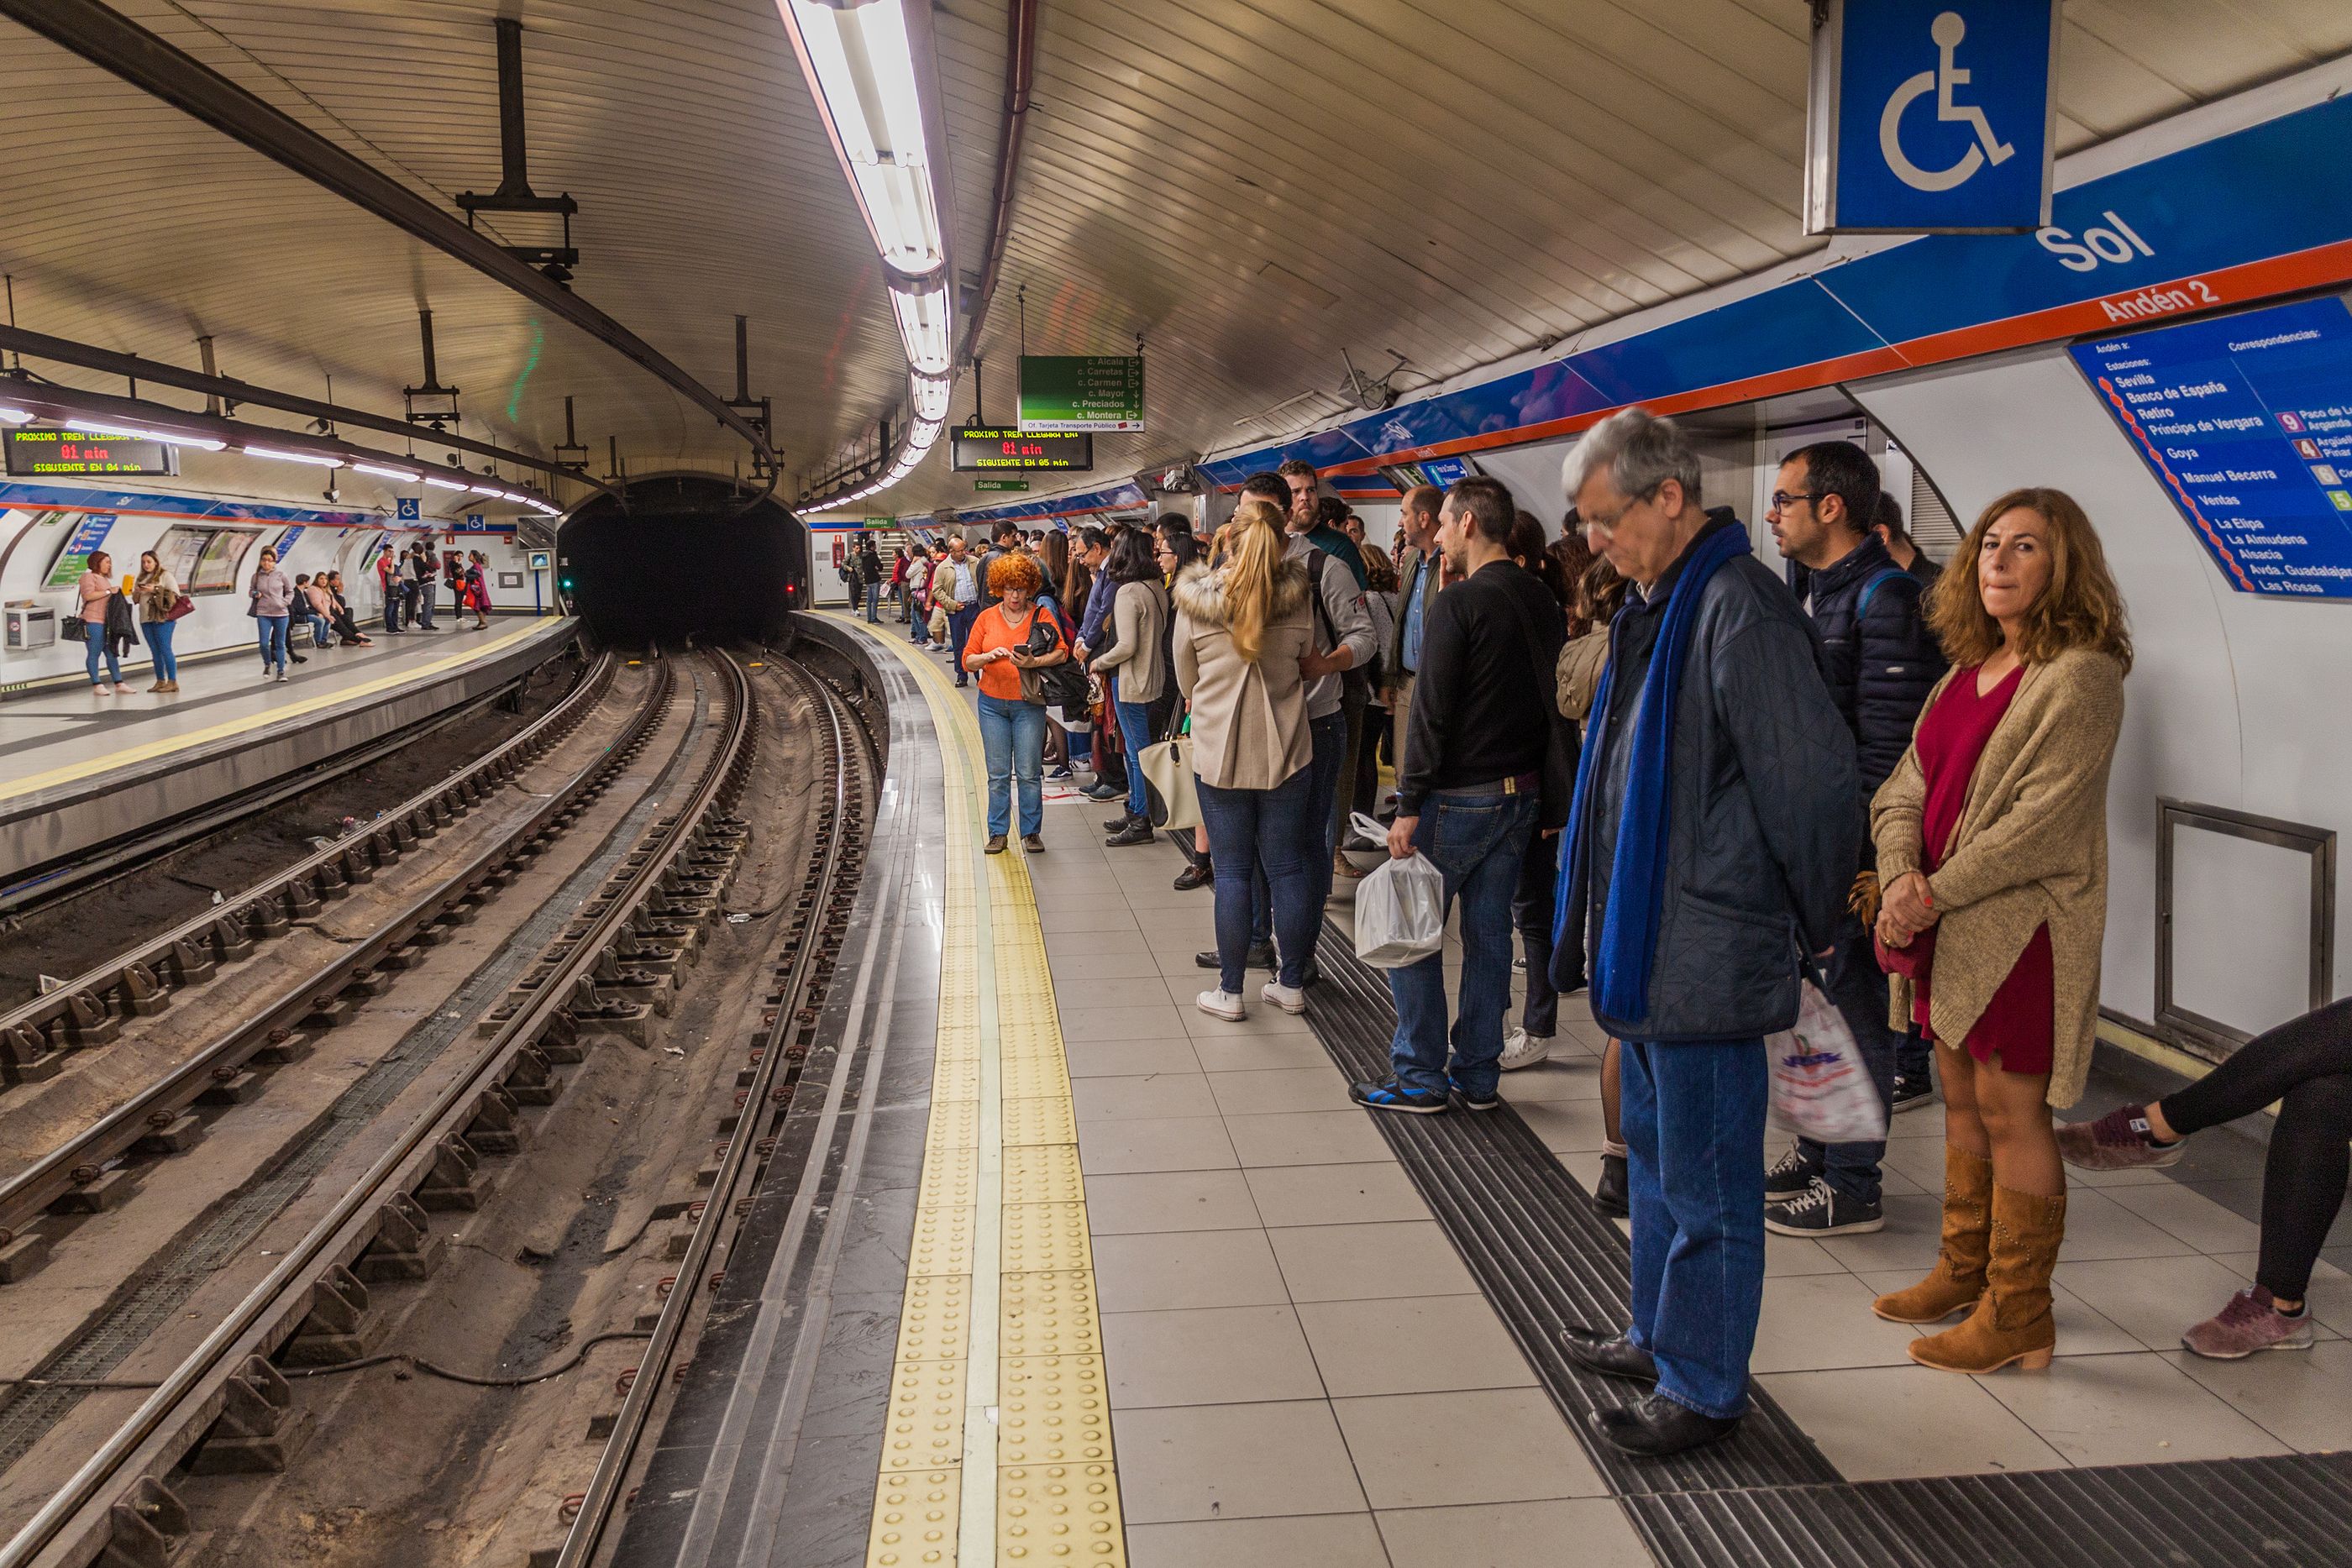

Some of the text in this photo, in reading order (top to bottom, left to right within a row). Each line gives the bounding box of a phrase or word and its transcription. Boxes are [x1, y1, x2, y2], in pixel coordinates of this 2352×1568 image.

[2035, 211, 2155, 272] Sol
[2099, 281, 2220, 322] Andén 2
[2229, 330, 2321, 351] Correspondencias:
[2096, 343, 2122, 354] Andén
[1087, 367, 1123, 375] Carretas
[2105, 359, 2152, 371] Estaciones:
[1087, 378, 1122, 386] Carmen
[2114, 374, 2155, 388] Sevilla
[1098, 389, 1125, 399] Mayor
[2125, 381, 2228, 404] Banco de España
[1082, 400, 1125, 408] Preciados
[1086, 411, 1121, 419] Montera
[2136, 406, 2175, 420] Retiro
[2281, 405, 2352, 431] 9 Paco de L
[1060, 421, 1092, 430] Transporte
[1094, 420, 1116, 428] Público
[1383, 420, 1415, 440] Sol
[2148, 416, 2265, 436] Príncipe de Vergara
[2307, 417, 2352, 432] Arganda
[14, 433, 58, 442] PROXIMO
[60, 433, 86, 441] TREN
[963, 430, 1000, 438] PROXIMO
[1002, 430, 1024, 438] TREN
[60, 444, 109, 459] 01 min
[1001, 442, 1043, 455] 01 min
[2166, 448, 2199, 460] Goya
[2301, 440, 2316, 457] 4
[2323, 448, 2351, 457] Pinar
[34, 463, 87, 473] SIGUIENTE
[88, 464, 102, 472] EN
[121, 463, 142, 472] min
[976, 459, 1021, 467] SIGUIENTE
[1023, 459, 1036, 467] EN
[1053, 459, 1069, 467] min
[2181, 469, 2278, 484] Manuel Becerra
[2318, 466, 2336, 483] 6
[978, 481, 1002, 490] Salida
[2197, 495, 2241, 506] Ventas
[2334, 493, 2351, 508] 5
[2214, 517, 2265, 531] La Elipa
[2226, 533, 2308, 545] La Almudena
[2239, 548, 2284, 560] Alsacia
[2250, 564, 2285, 576] Avda.
[2258, 579, 2324, 593] Las Rosas
